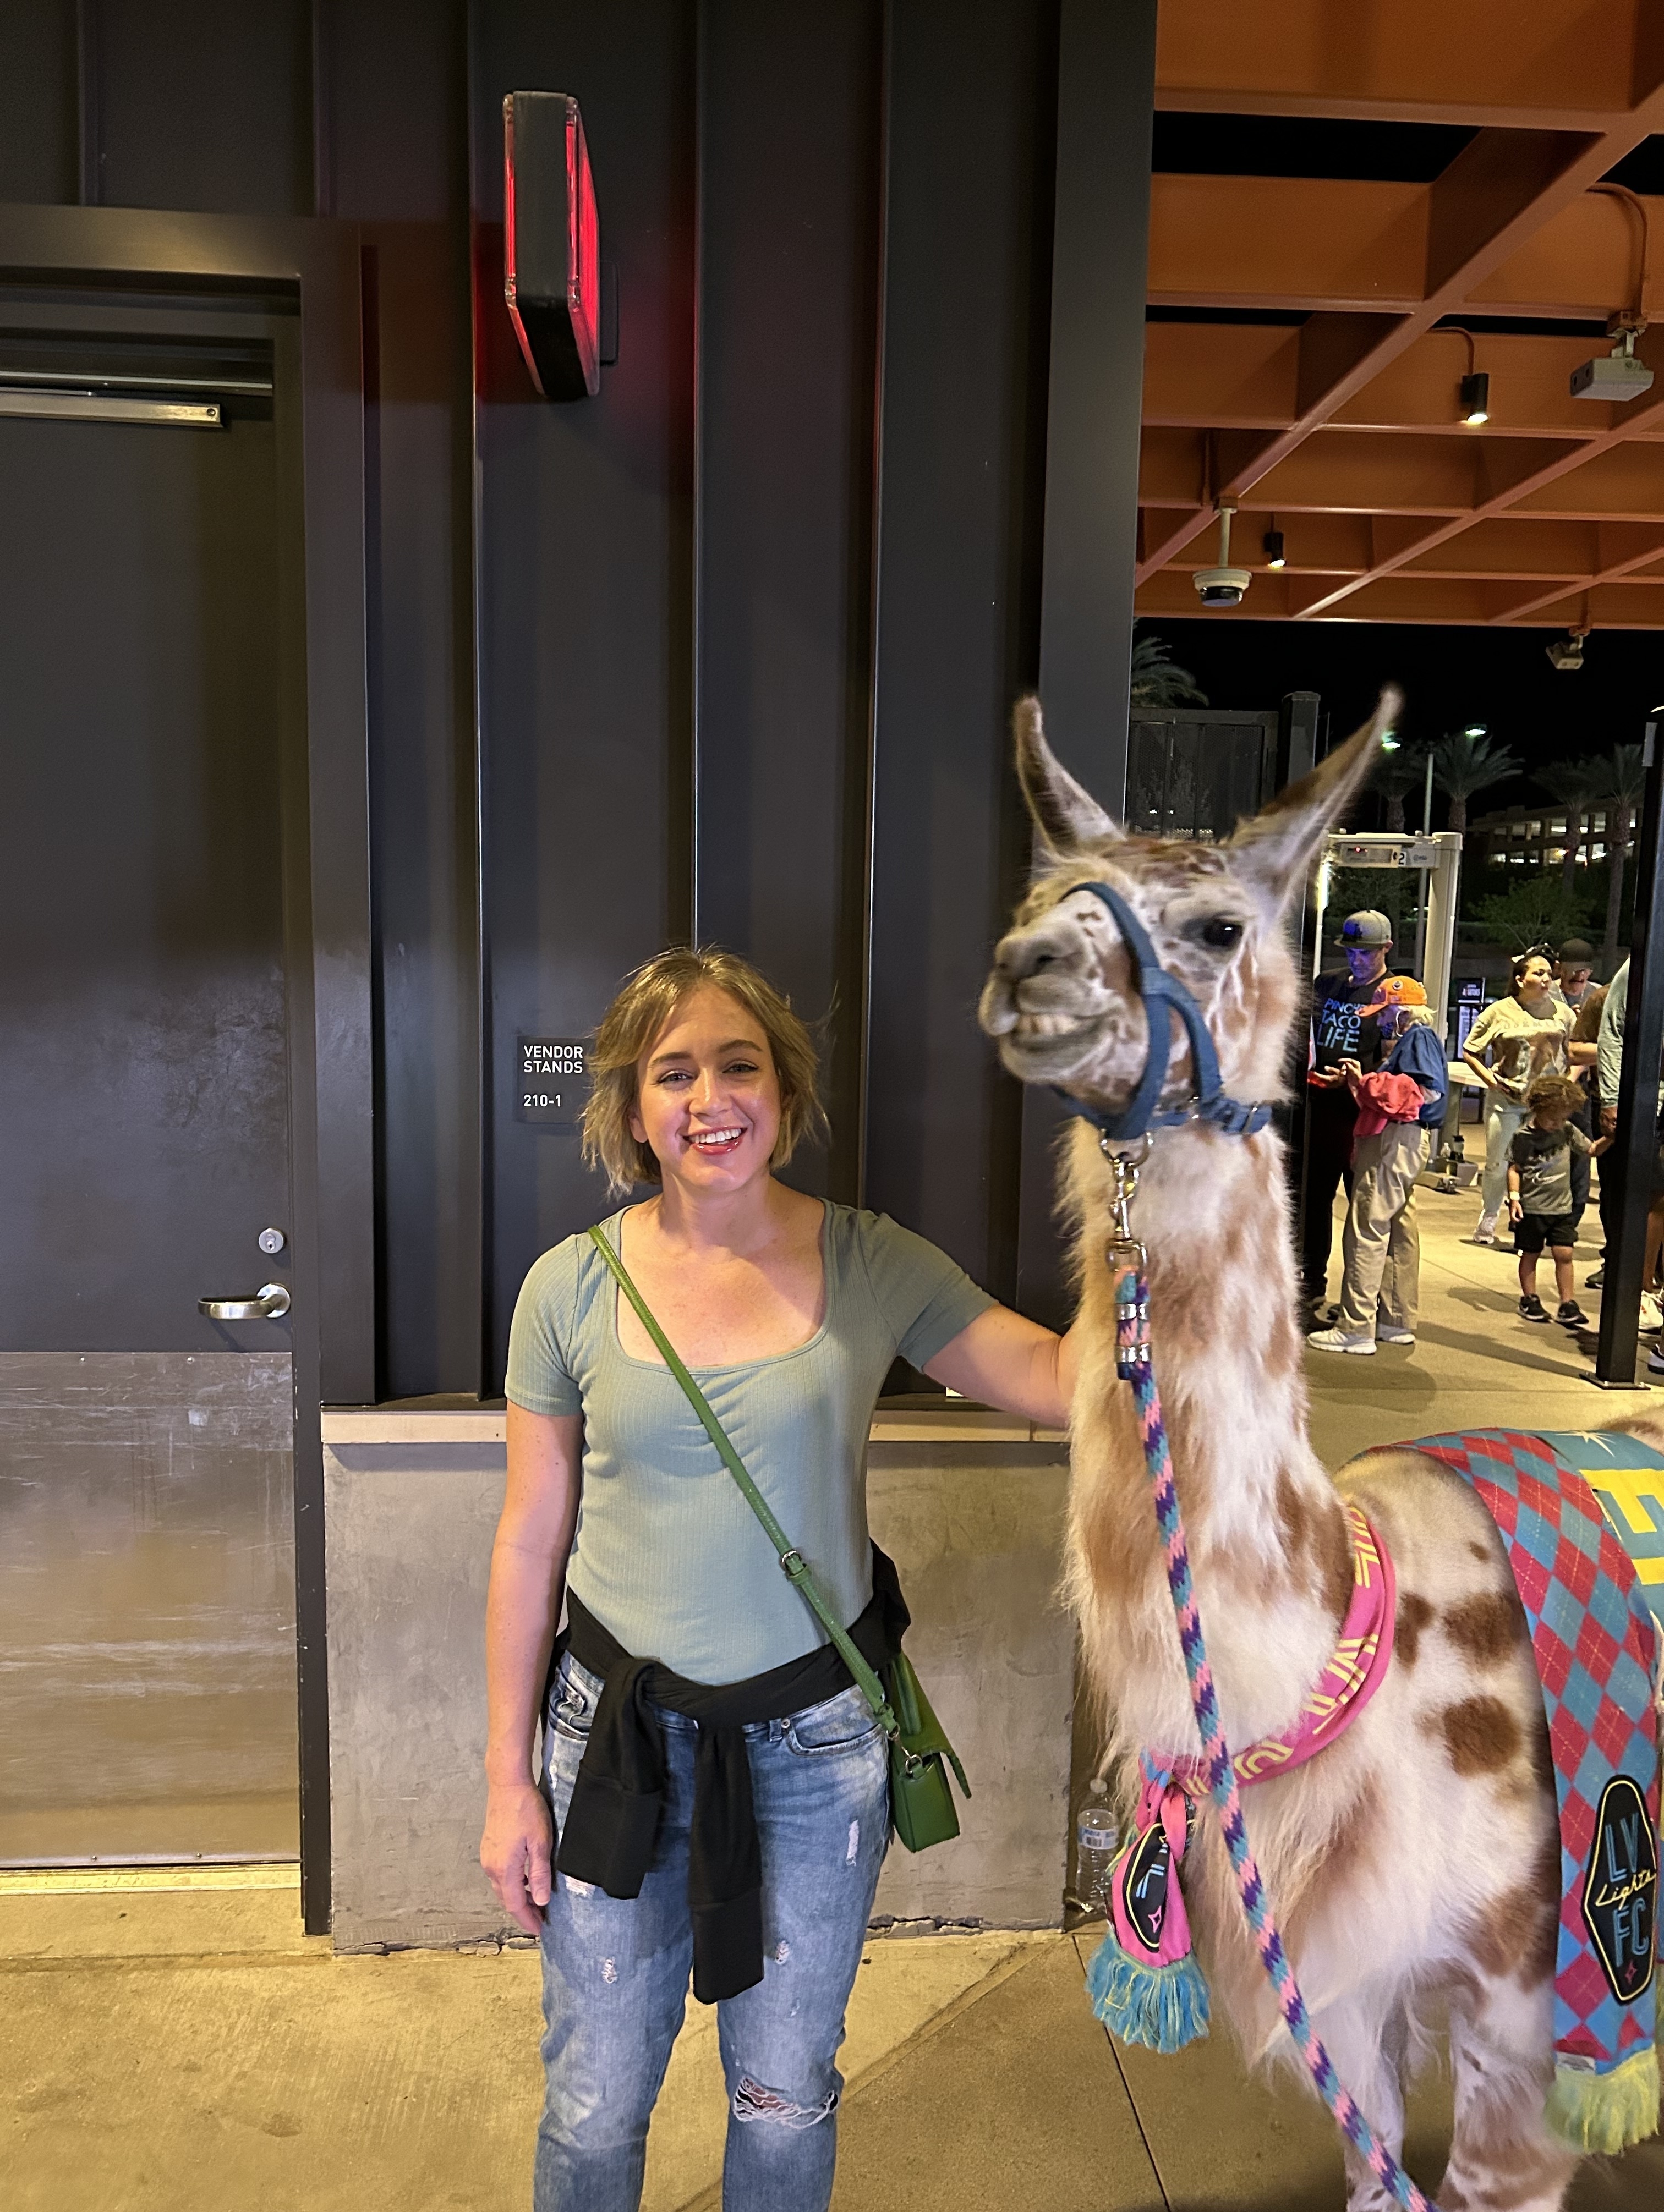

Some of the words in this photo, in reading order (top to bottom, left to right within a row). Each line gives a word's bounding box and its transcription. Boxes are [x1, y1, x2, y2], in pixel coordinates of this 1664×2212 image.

[1398, 852, 1405, 865] 2
[1322, 1009, 1361, 1029] TACO
[1317, 1024, 1360, 1052] LIFE
[523, 1045, 583, 1058] VENDOR
[524, 1060, 583, 1073] STANDS
[523, 1094, 561, 1107] 210-1
[1605, 1812, 1639, 1882] LV
[1595, 1869, 1657, 1911] Lights
[1613, 1897, 1649, 1967] FC
